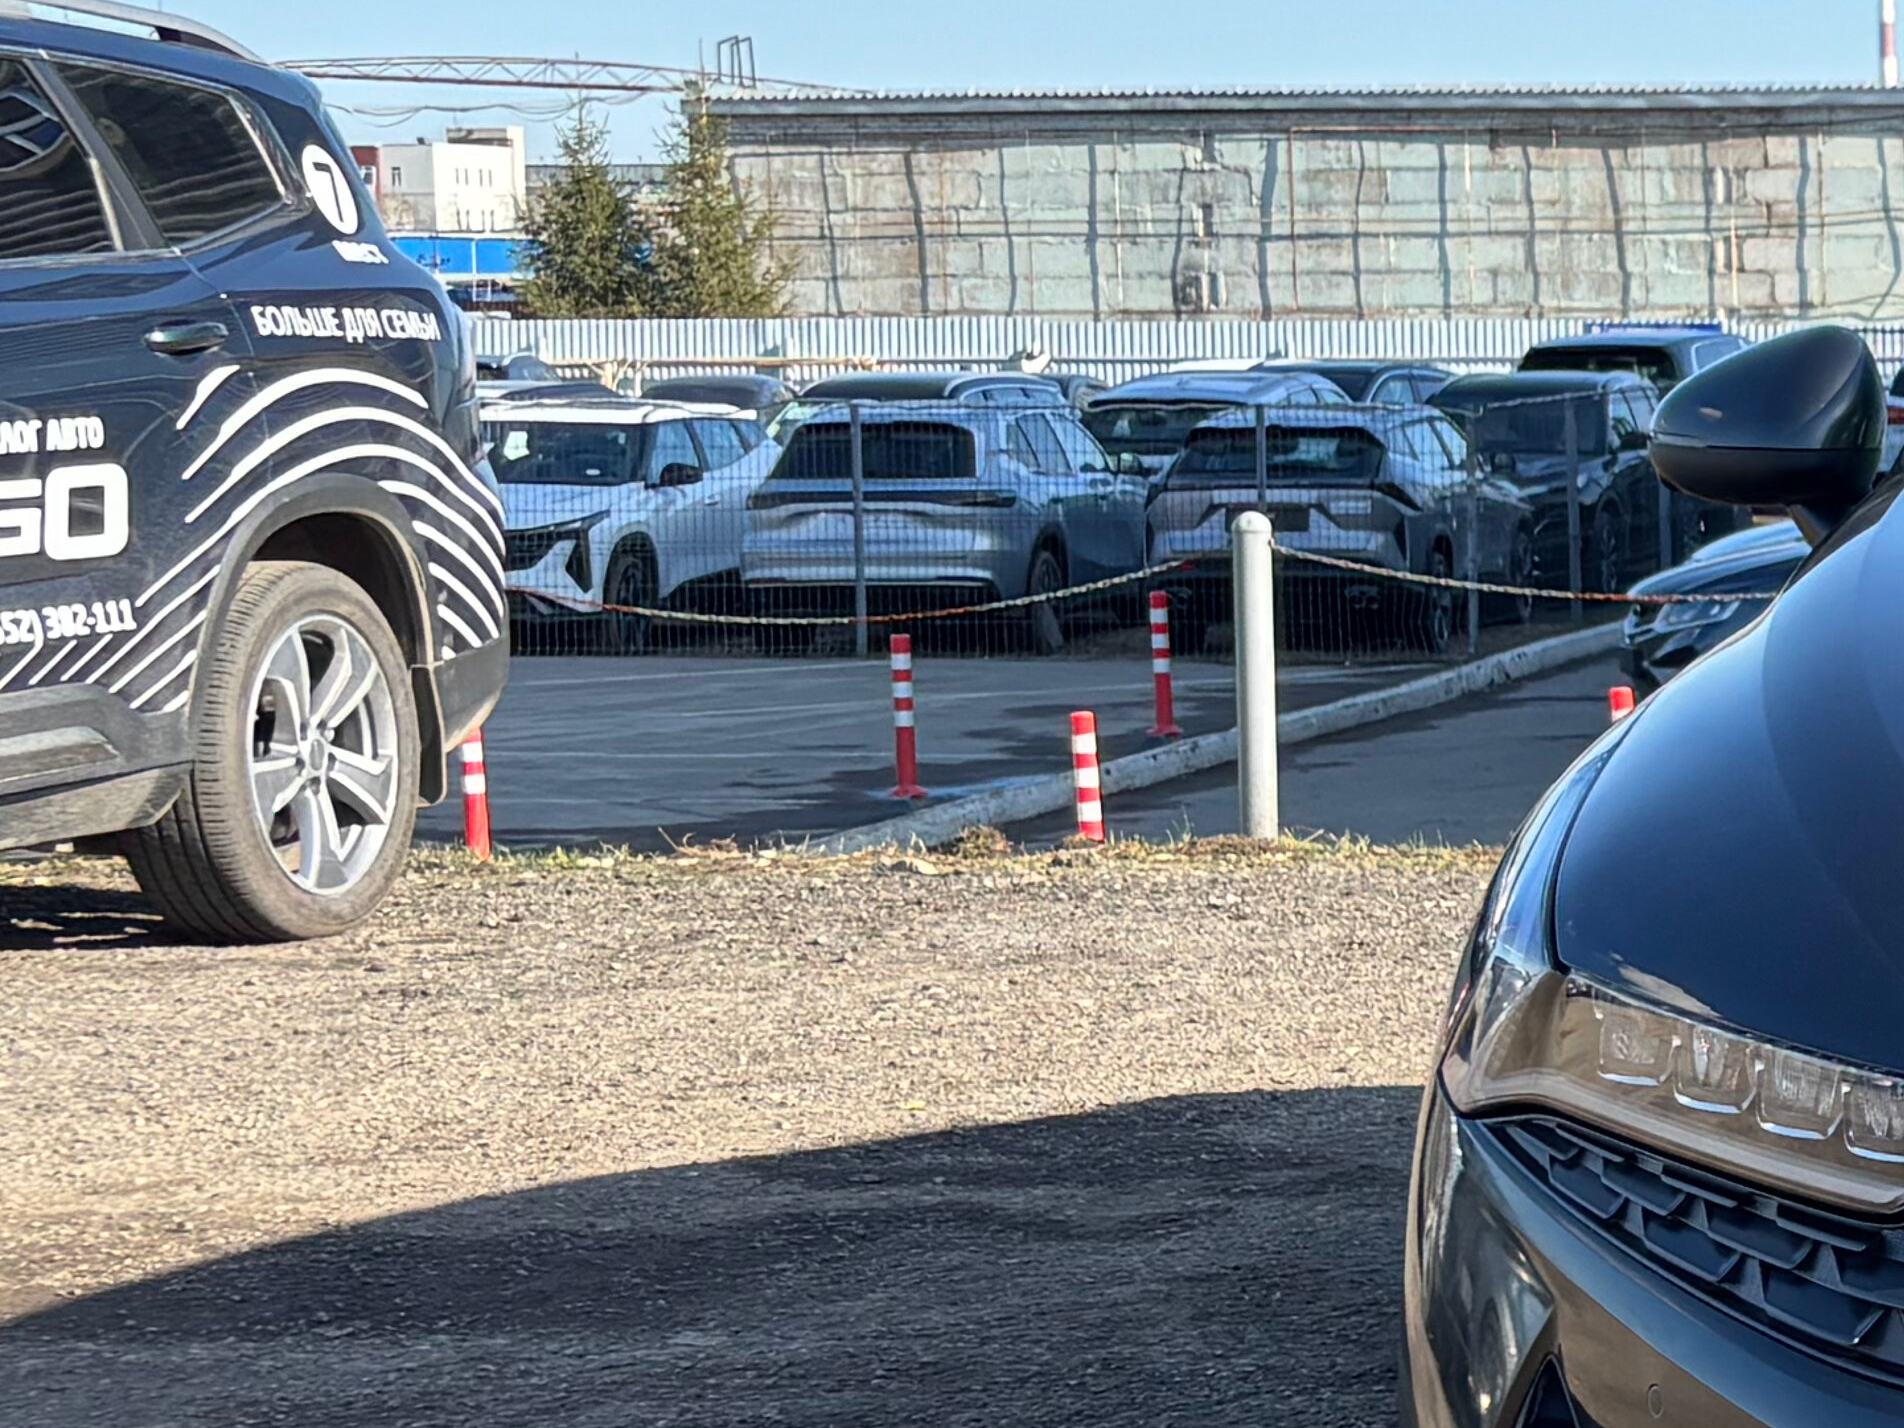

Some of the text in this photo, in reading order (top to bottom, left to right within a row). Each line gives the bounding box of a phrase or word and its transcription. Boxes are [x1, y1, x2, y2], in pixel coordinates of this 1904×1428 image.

[312, 161, 345, 224] 7
[250, 305, 441, 344] БОЛЬШЕ ДЛЯ СЕМЬИ
[46, 416, 104, 451] АВТО
